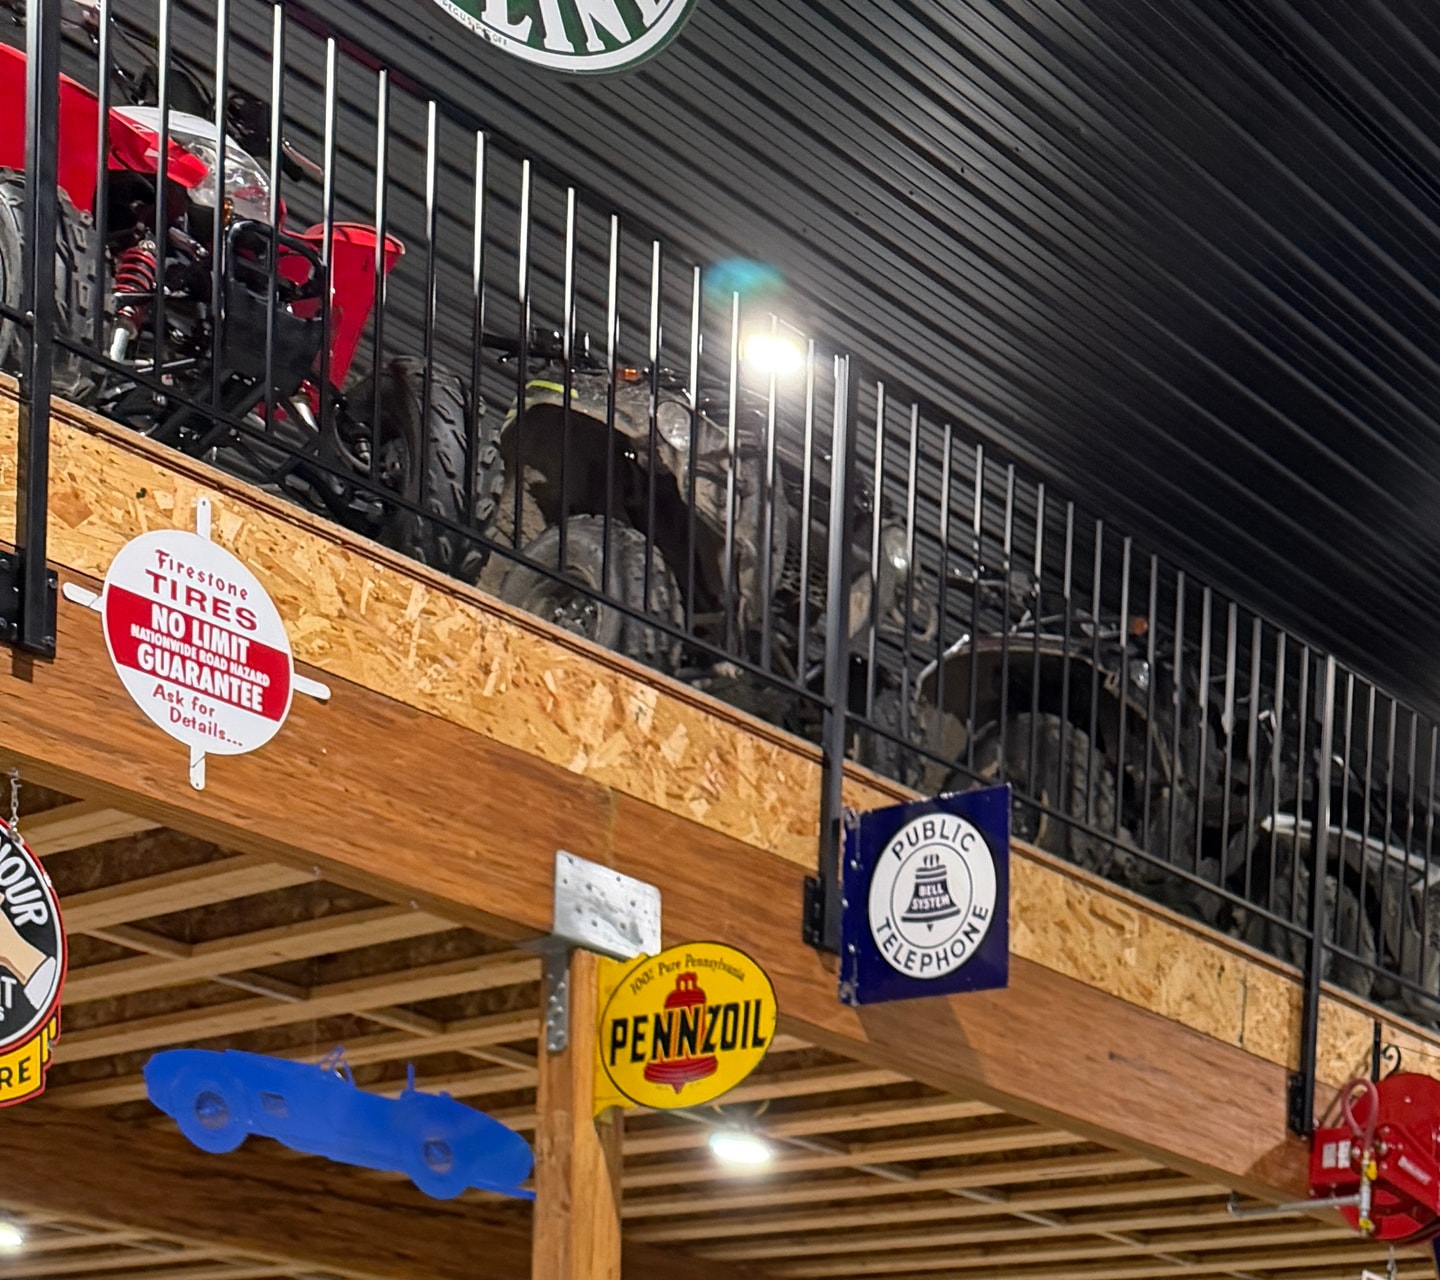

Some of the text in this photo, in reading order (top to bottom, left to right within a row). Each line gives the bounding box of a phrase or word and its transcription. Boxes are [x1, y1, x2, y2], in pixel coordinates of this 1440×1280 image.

[145, 569, 257, 631] TIRES
[155, 549, 248, 600] Firestone
[130, 624, 270, 688] NATIONWIDE ROAD HAZARD
[152, 604, 250, 664] NO LIMIT
[137, 643, 263, 712] GUARANTEE
[152, 684, 215, 718] Ask for
[892, 819, 975, 861] PUBLIC
[0, 843, 49, 926] OUR
[911, 895, 950, 910] SYSTEM
[918, 884, 944, 897] BELL
[659, 960, 681, 976] Pure
[685, 954, 745, 982] Pennsylvania
[877, 904, 988, 972] TELEPHONE
[610, 999, 767, 1066] PENNZOIL
